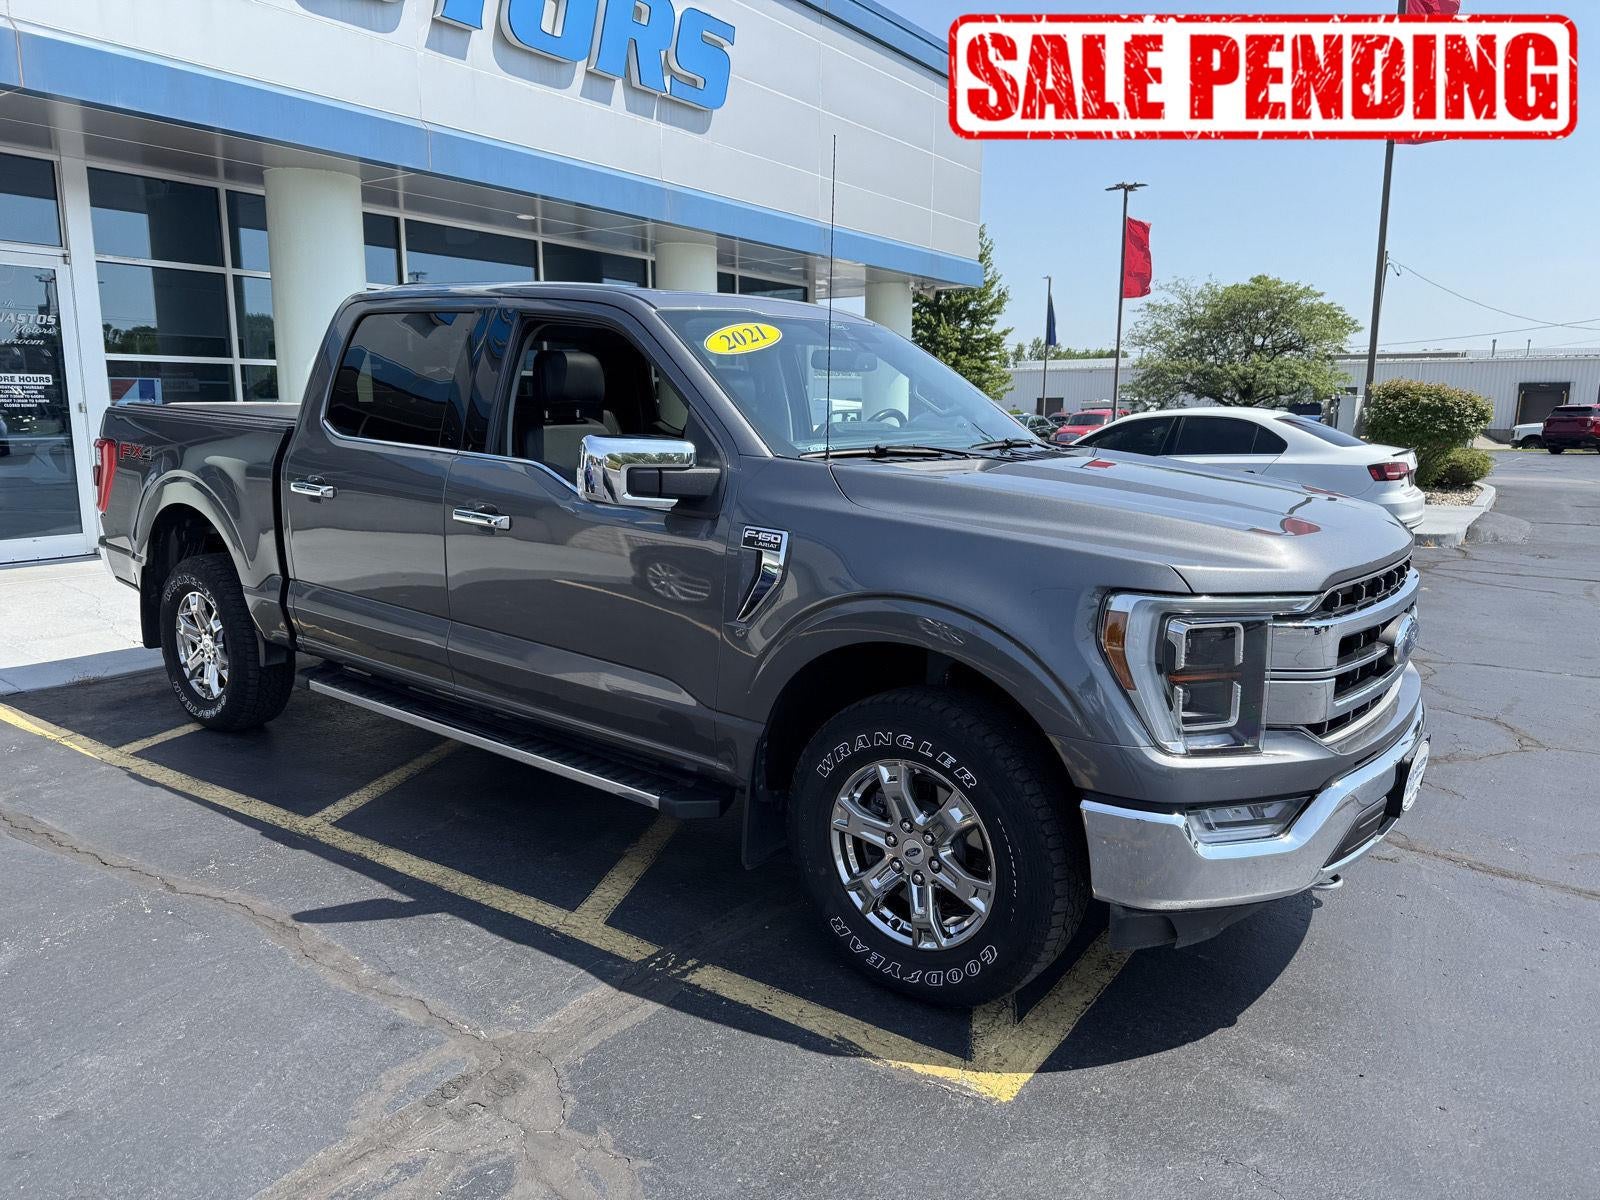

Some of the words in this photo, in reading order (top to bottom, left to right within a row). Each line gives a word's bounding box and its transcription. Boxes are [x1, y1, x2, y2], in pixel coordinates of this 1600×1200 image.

[719, 325, 768, 350] 2021
[119, 441, 152, 461] FX4
[744, 530, 782, 543] F-150
[754, 541, 778, 549] LARIAT
[815, 731, 978, 790] WRANGLER
[829, 916, 998, 987] GOODYEAR
